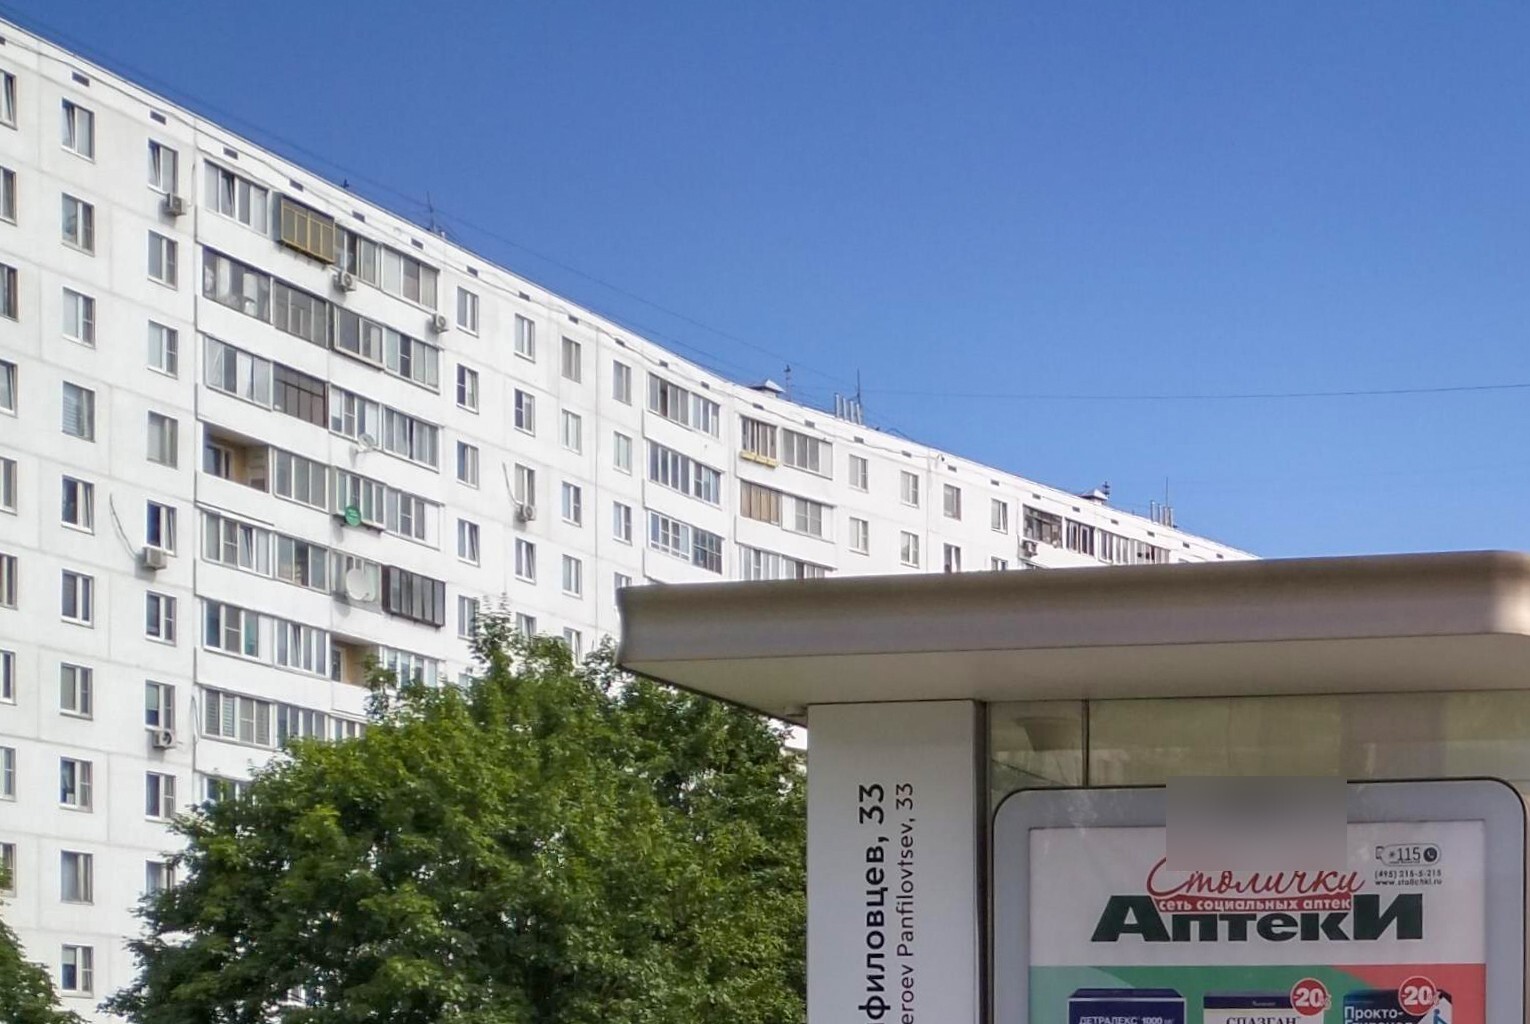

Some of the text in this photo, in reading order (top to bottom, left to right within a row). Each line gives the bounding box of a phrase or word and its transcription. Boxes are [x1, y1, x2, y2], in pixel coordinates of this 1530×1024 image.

[859, 784, 884, 825] 33
[896, 783, 914, 810] 33
[896, 818, 916, 957] Panfilovtsev,
[1160, 898, 1351, 913] сеть социальных аптек
[1344, 1005, 1404, 1021] Прокто-
